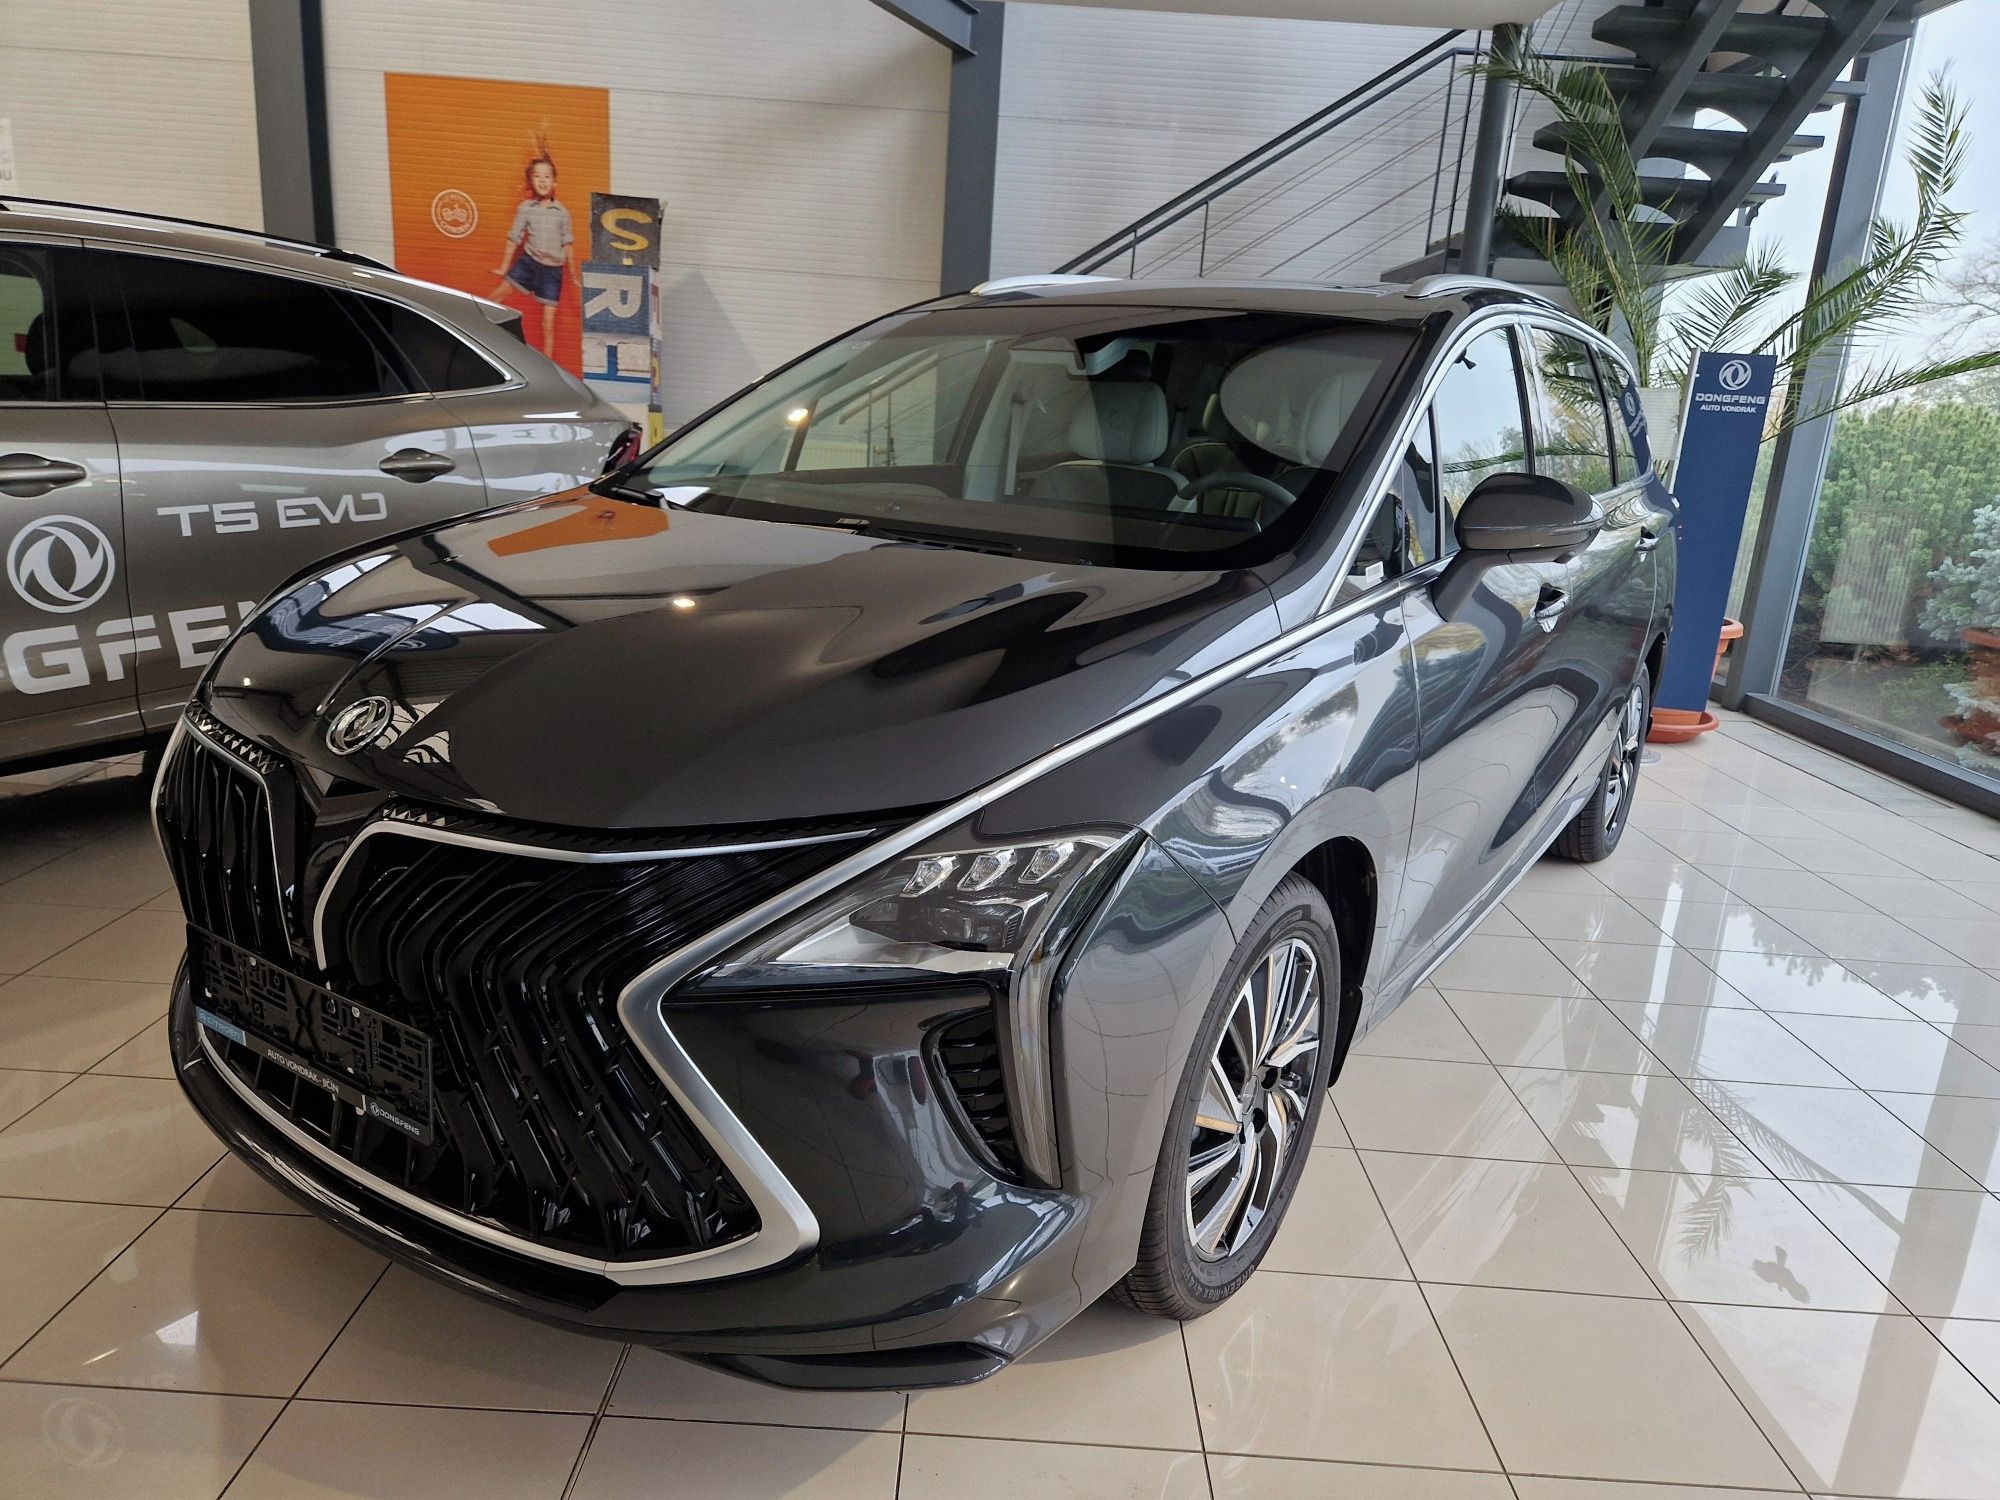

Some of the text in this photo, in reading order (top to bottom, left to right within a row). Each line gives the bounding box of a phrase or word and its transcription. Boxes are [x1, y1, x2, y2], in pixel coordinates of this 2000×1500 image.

[1695, 392, 1766, 405] DONGFENG
[1721, 404, 1757, 413] VONDRÁK
[157, 492, 388, 537] T5 EVO
[267, 1048, 285, 1064] AUTO
[379, 1108, 420, 1136] DONGFENG
